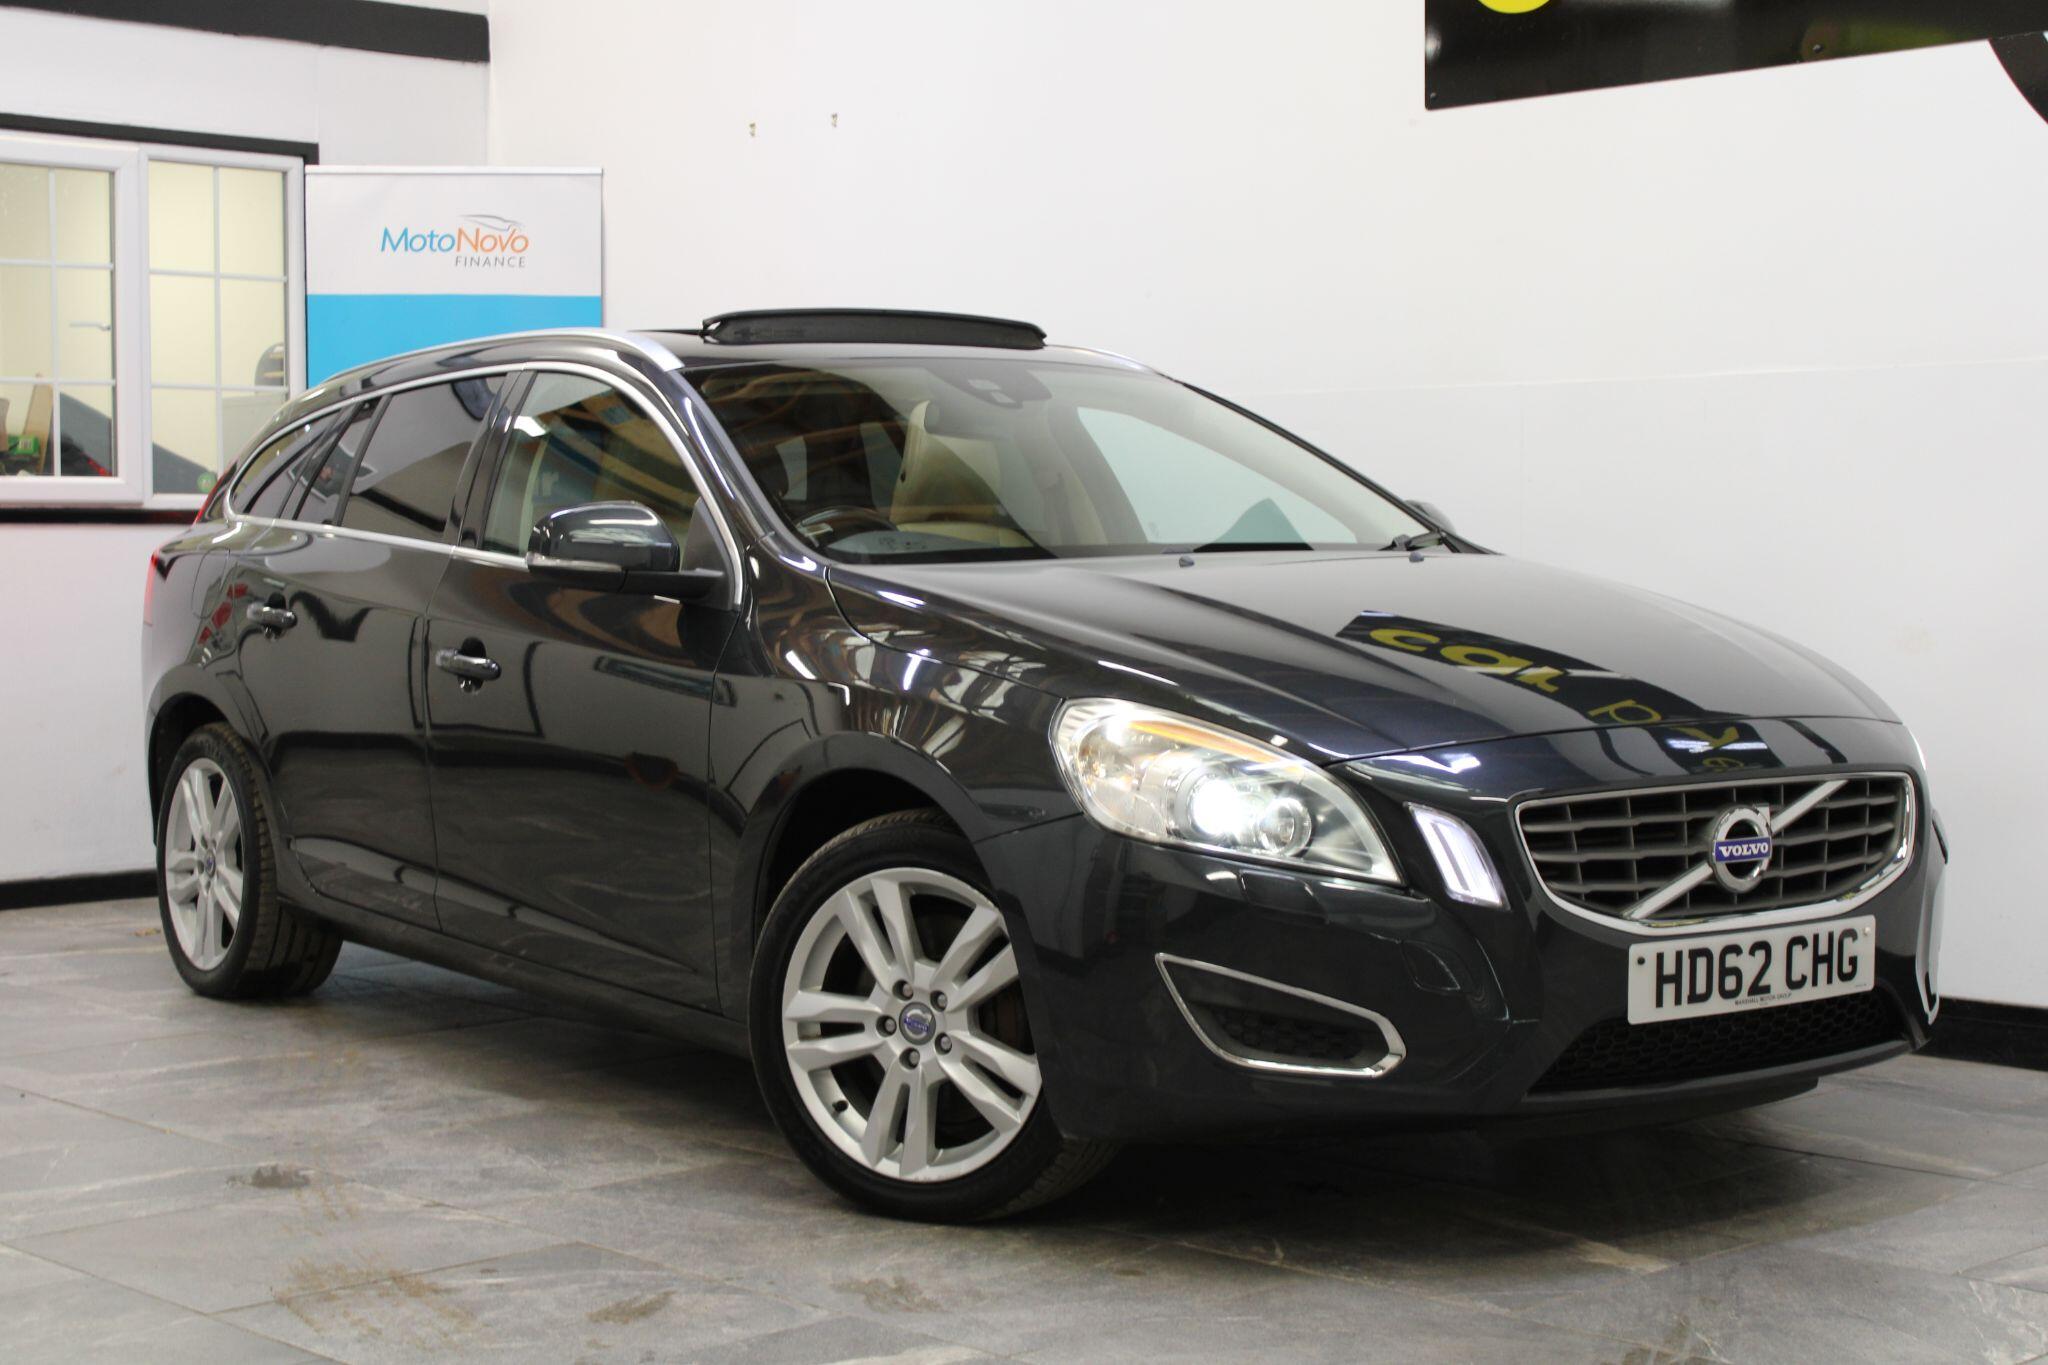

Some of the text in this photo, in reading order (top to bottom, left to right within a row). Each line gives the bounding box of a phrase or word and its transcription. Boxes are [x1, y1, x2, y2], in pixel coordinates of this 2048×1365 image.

[381, 228, 529, 254] MotoNovo
[455, 256, 526, 268] FINANCE
[1719, 842, 1769, 858] VOLVO
[1656, 928, 1859, 1009] HD62 CHG
